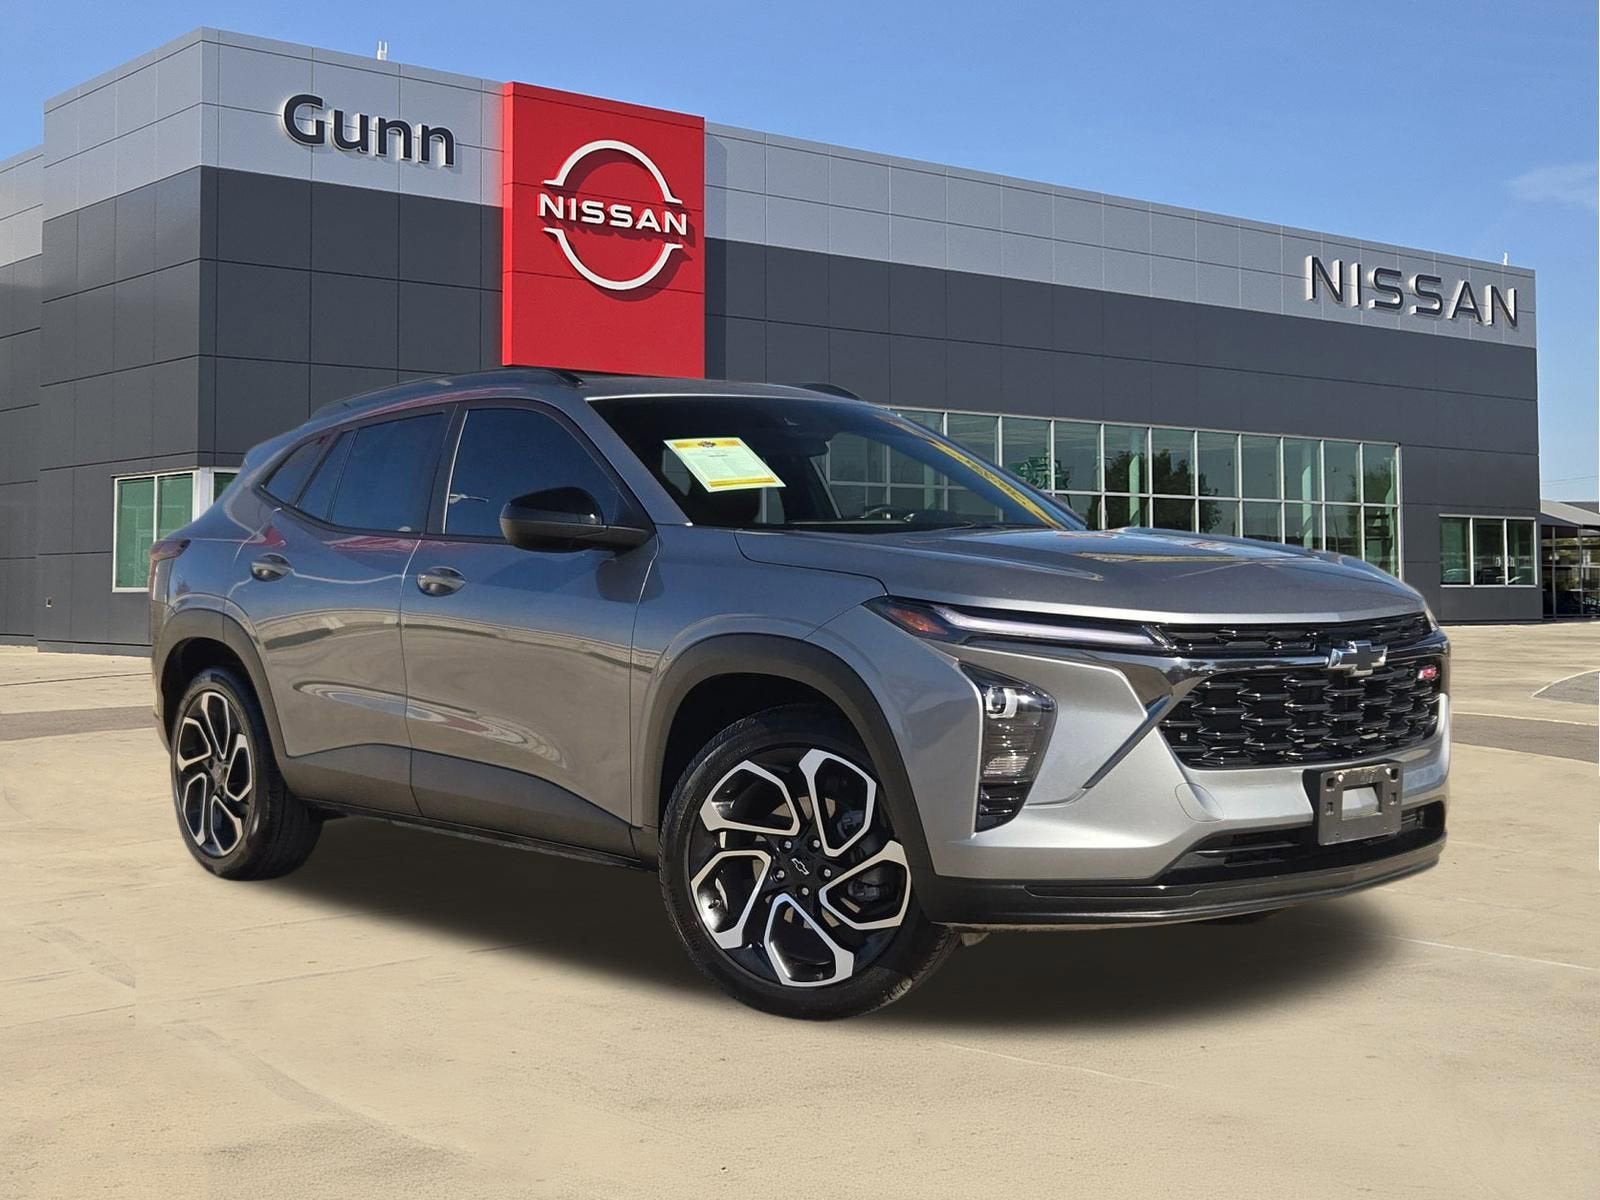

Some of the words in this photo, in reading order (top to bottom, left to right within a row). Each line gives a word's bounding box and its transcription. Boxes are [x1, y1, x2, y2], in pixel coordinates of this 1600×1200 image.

[282, 93, 455, 167] Gunn
[538, 193, 687, 236] NISSAN
[1305, 255, 1518, 328] NISSAN
